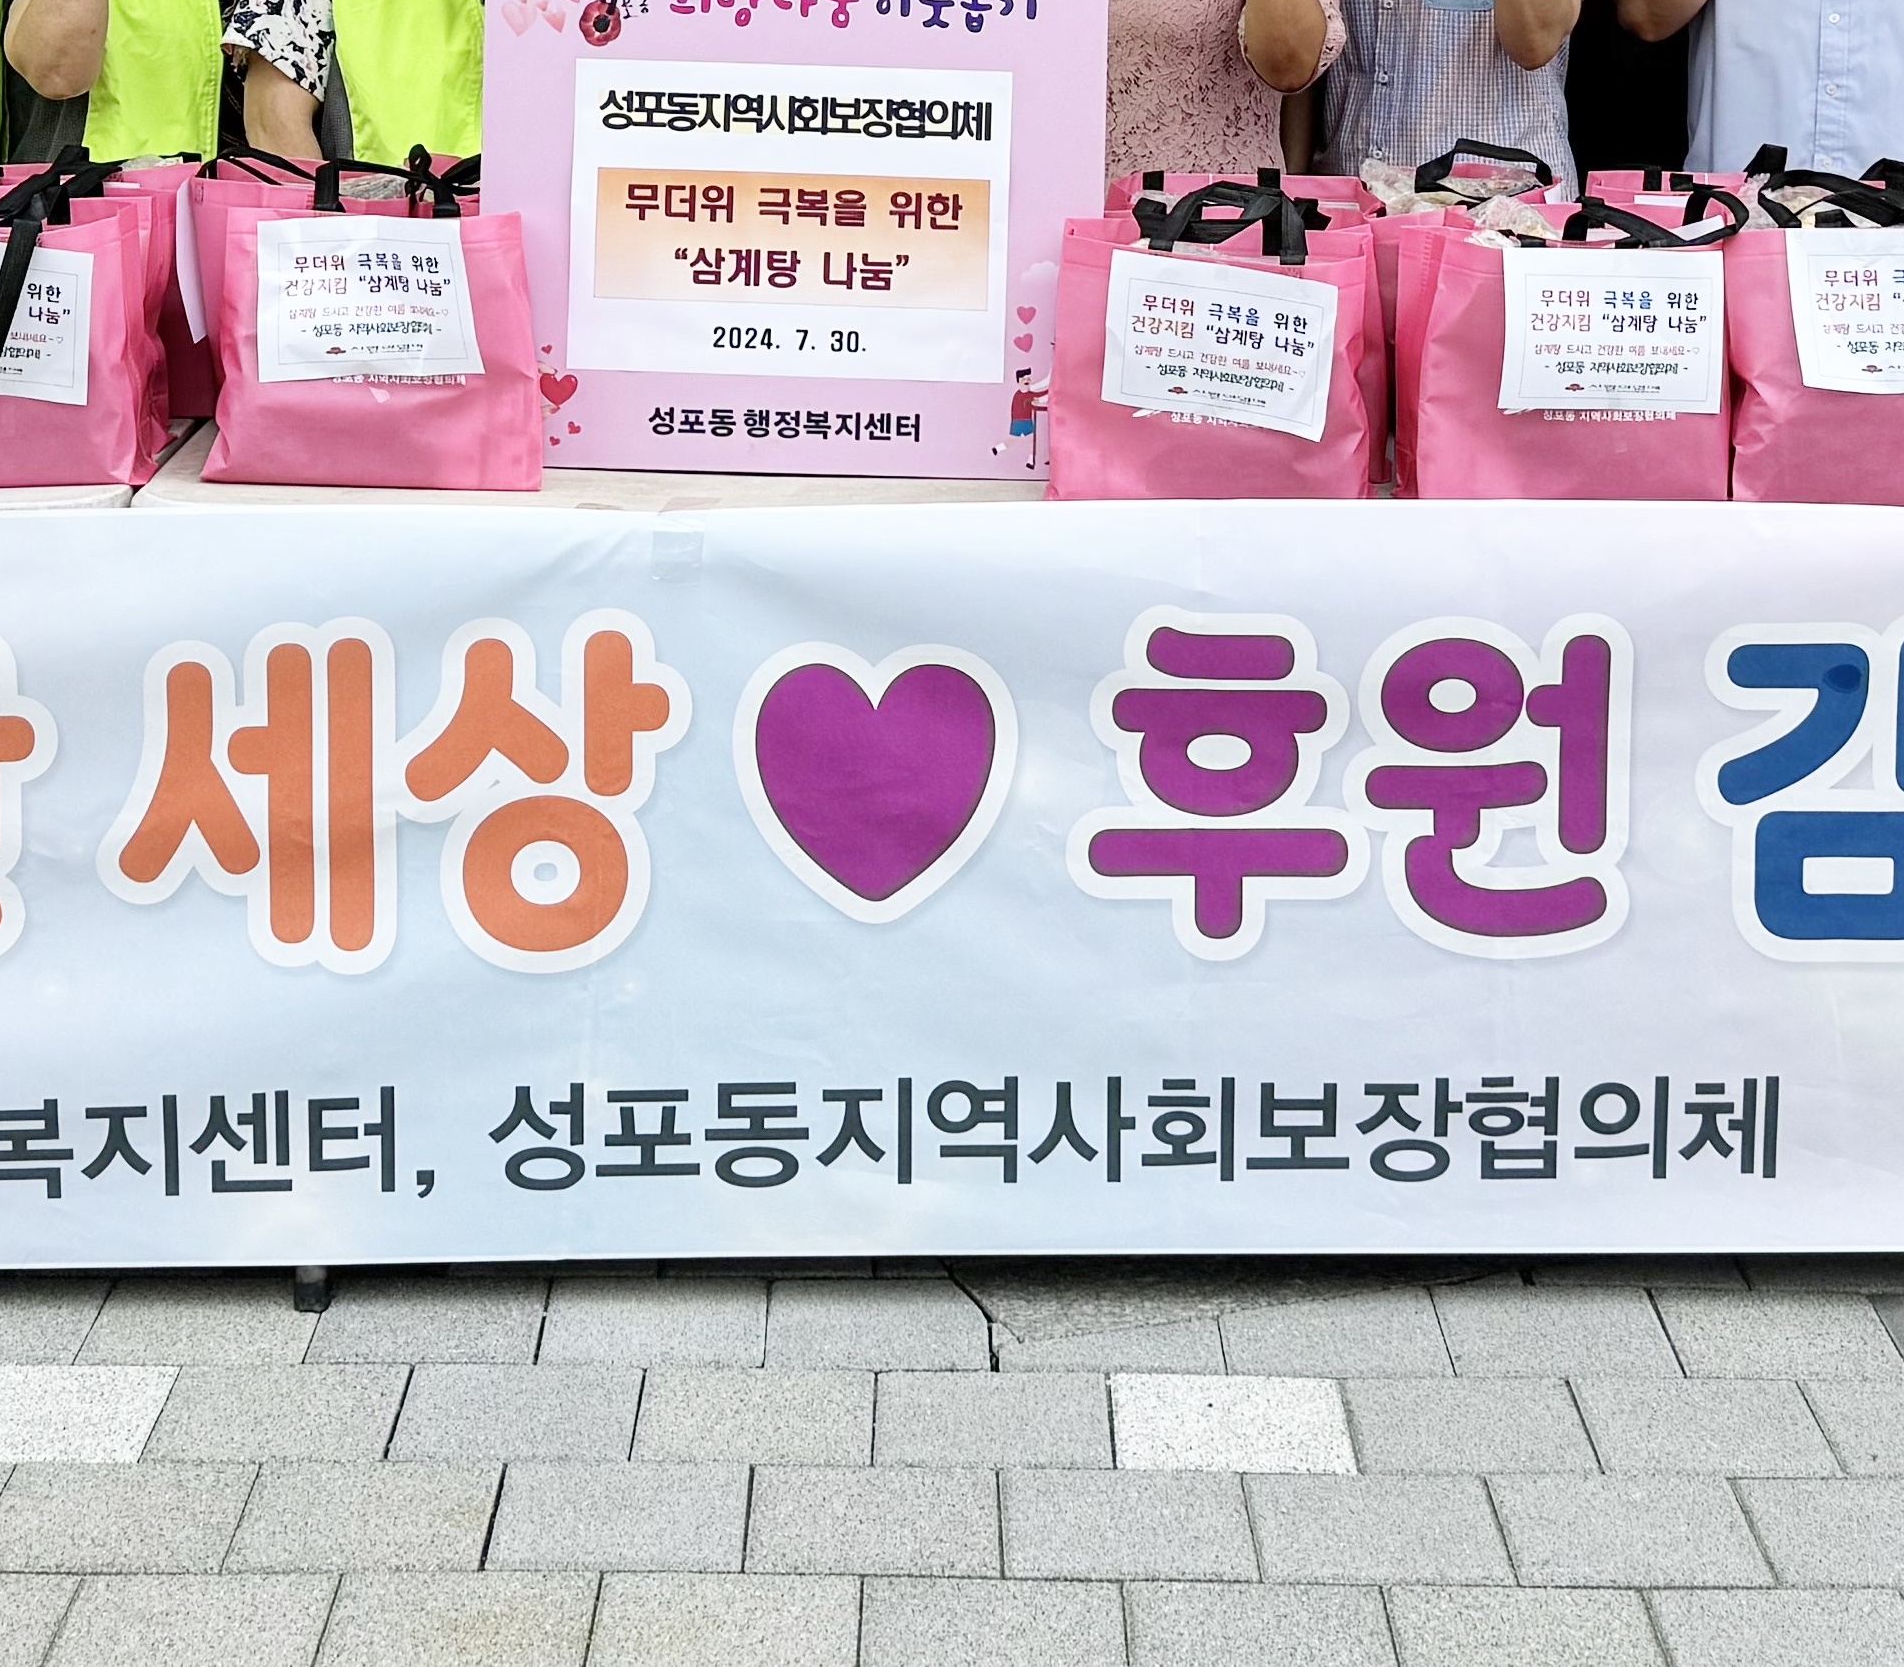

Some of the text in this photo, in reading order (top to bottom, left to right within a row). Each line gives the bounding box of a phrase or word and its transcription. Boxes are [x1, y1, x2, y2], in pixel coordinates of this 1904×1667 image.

[600, 89, 992, 142] 성포동지역사회보장협의체
[626, 183, 963, 231] 무더위 극복을 위한
[673, 247, 910, 291] “삼계탕 나눔”
[1825, 270, 1878, 287] 무더위
[26, 283, 61, 303] 위한
[1540, 290, 1699, 310] 무더위 극복을 위한
[1143, 295, 1308, 334] 무더위 극복을 위한
[712, 326, 867, 354] 2024. 7. 30.
[118, 627, 672, 955] 세상
[1086, 624, 1609, 941] 후원
[486, 1072, 1783, 1190] 성포동지역사회보장협의체
